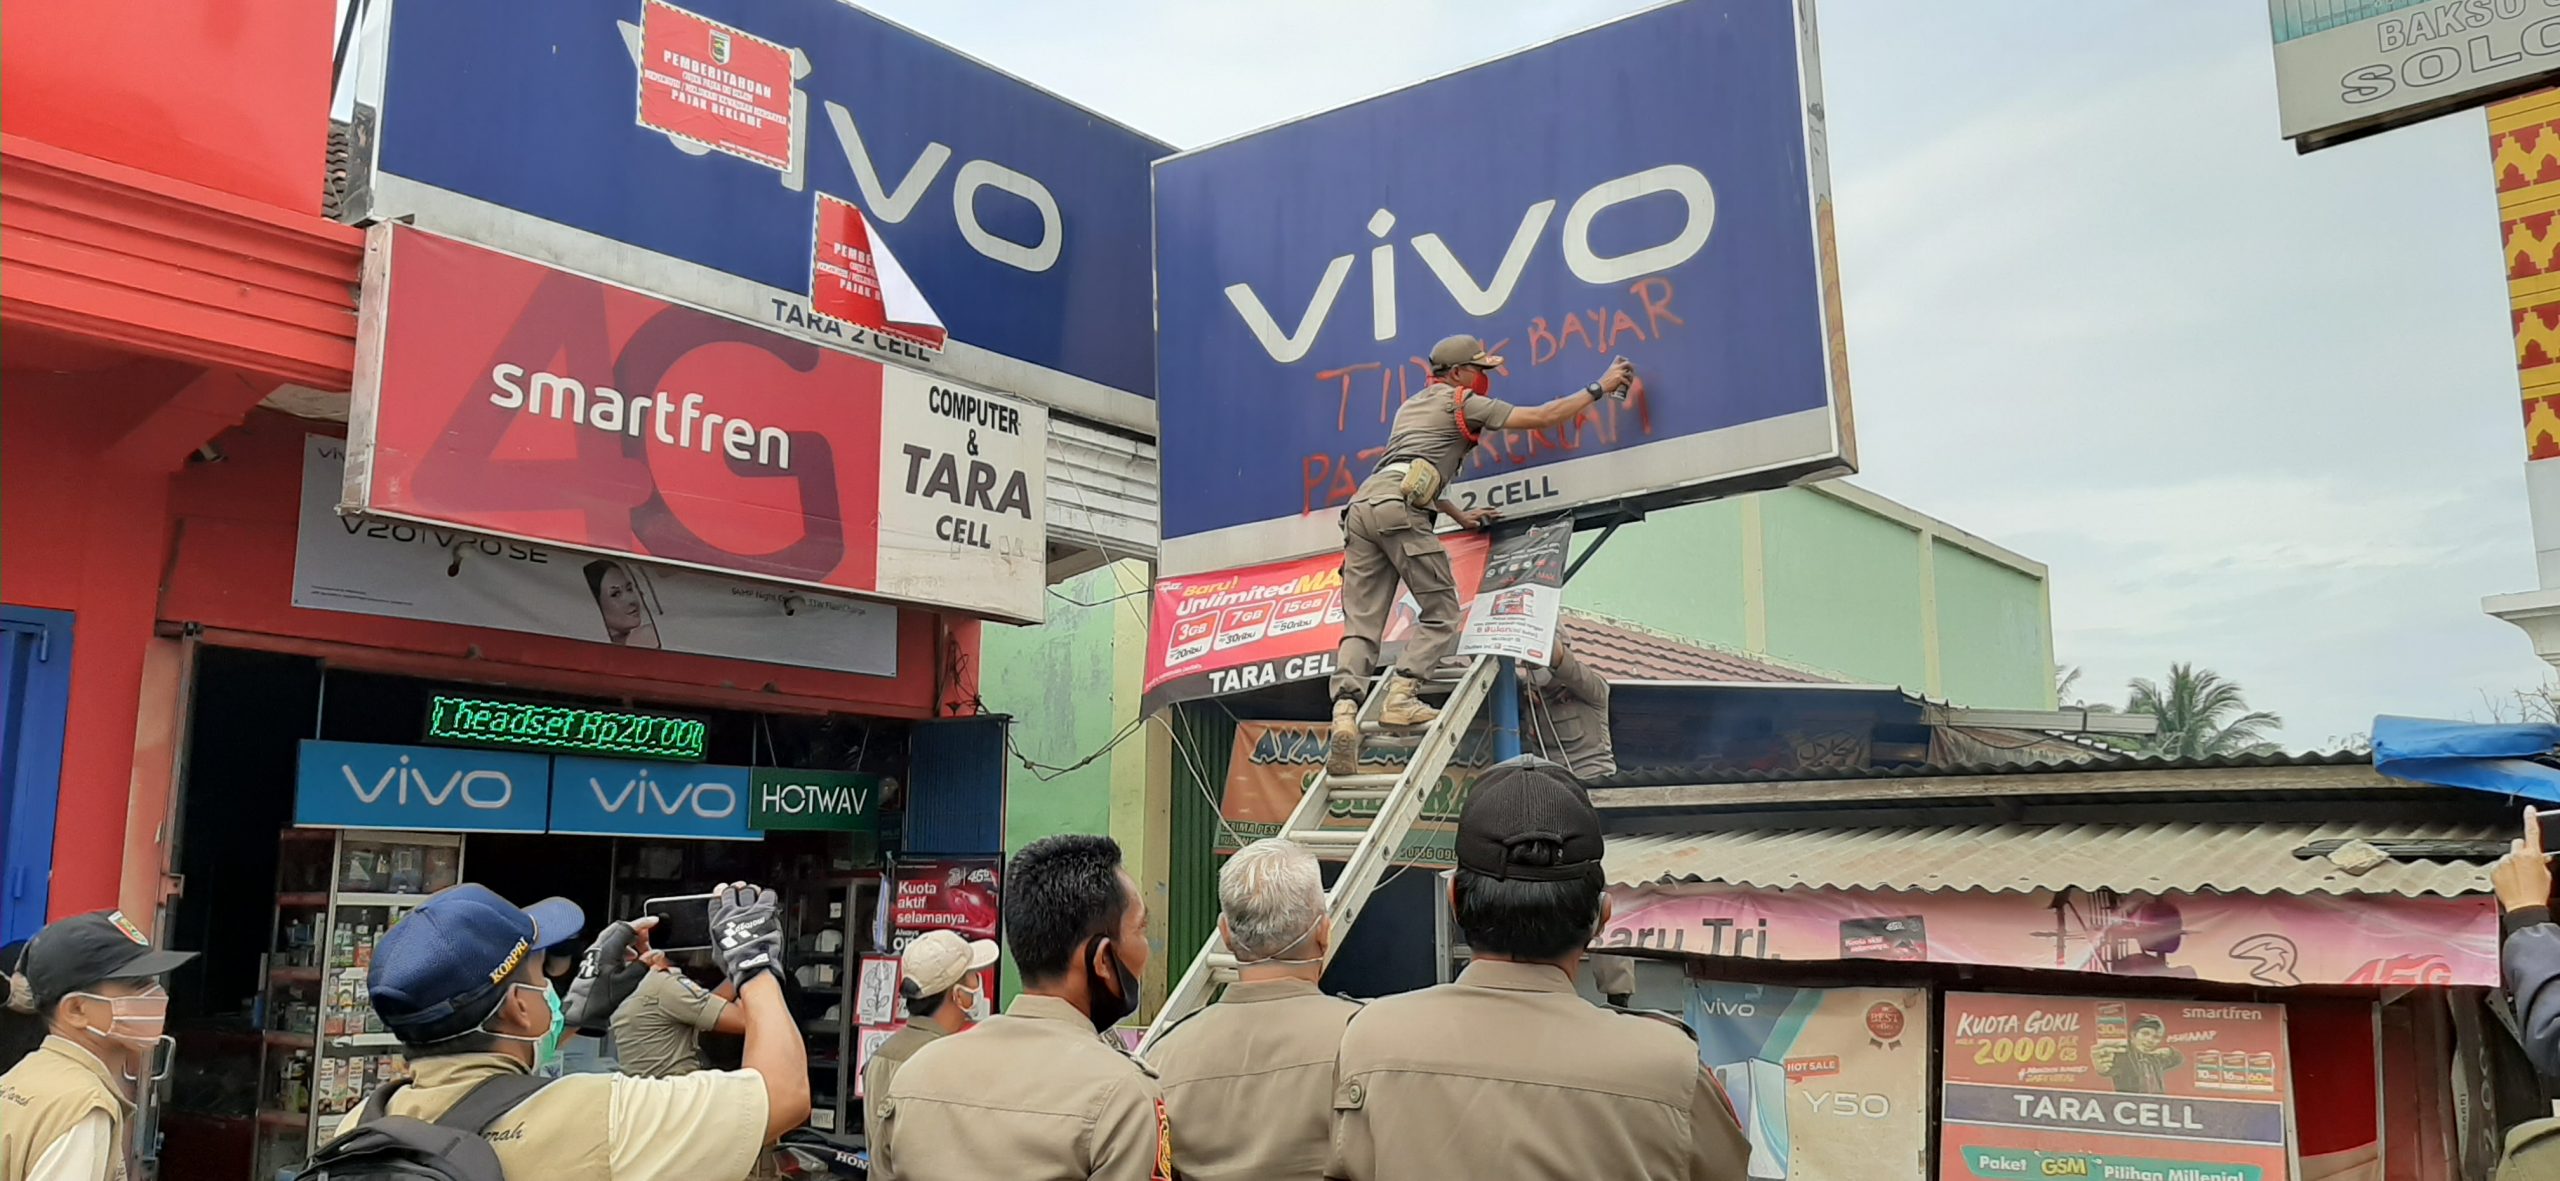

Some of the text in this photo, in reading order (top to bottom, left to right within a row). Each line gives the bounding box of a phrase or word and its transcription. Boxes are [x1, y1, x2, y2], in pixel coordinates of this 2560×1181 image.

[2377, 0, 2526, 53] BAKSO
[2341, 16, 2560, 104] SOLO
[671, 89, 707, 110] PAJAK
[711, 101, 763, 128] REKLAME
[617, 20, 1063, 272] ivo
[1224, 163, 1716, 364] vivo
[772, 298, 842, 338] TARA
[1315, 277, 1685, 434] TIDK BAYAR
[489, 362, 791, 470] smartfren
[929, 385, 1020, 436] COMPUTER
[966, 428, 979, 456] &
[903, 443, 1032, 520] TARA
[1461, 476, 1559, 511] 2 CELL
[936, 515, 991, 549] CELL
[508, 543, 548, 563] SE
[1183, 576, 1240, 597] Baru!
[1178, 598, 1324, 641] 3GB 7GB 15GB
[1208, 662, 1276, 694] TARA
[1284, 653, 1337, 681] CEL
[342, 755, 737, 818] vivo vivo
[761, 783, 869, 816] HOTWAV
[897, 896, 927, 909] aktif
[898, 881, 937, 895] Kuota
[897, 910, 969, 927] selamanya.
[1702, 918, 1782, 959] Tri.
[488, 936, 529, 985] KORPRI
[1703, 998, 1756, 1017] vivo
[1956, 1010, 2081, 1037] KUOTA GOKIL
[2182, 1007, 2262, 1020] smartfren
[1787, 1060, 1836, 1072] HOT SALE
[1974, 1036, 2057, 1065] 2000
[1802, 1090, 1890, 1119] Y50
[2013, 1094, 2204, 1130] TARA CELL
[835, 1150, 870, 1170] HON
[1979, 1155, 2244, 1181] Paket GSM Pilihan Millenial
